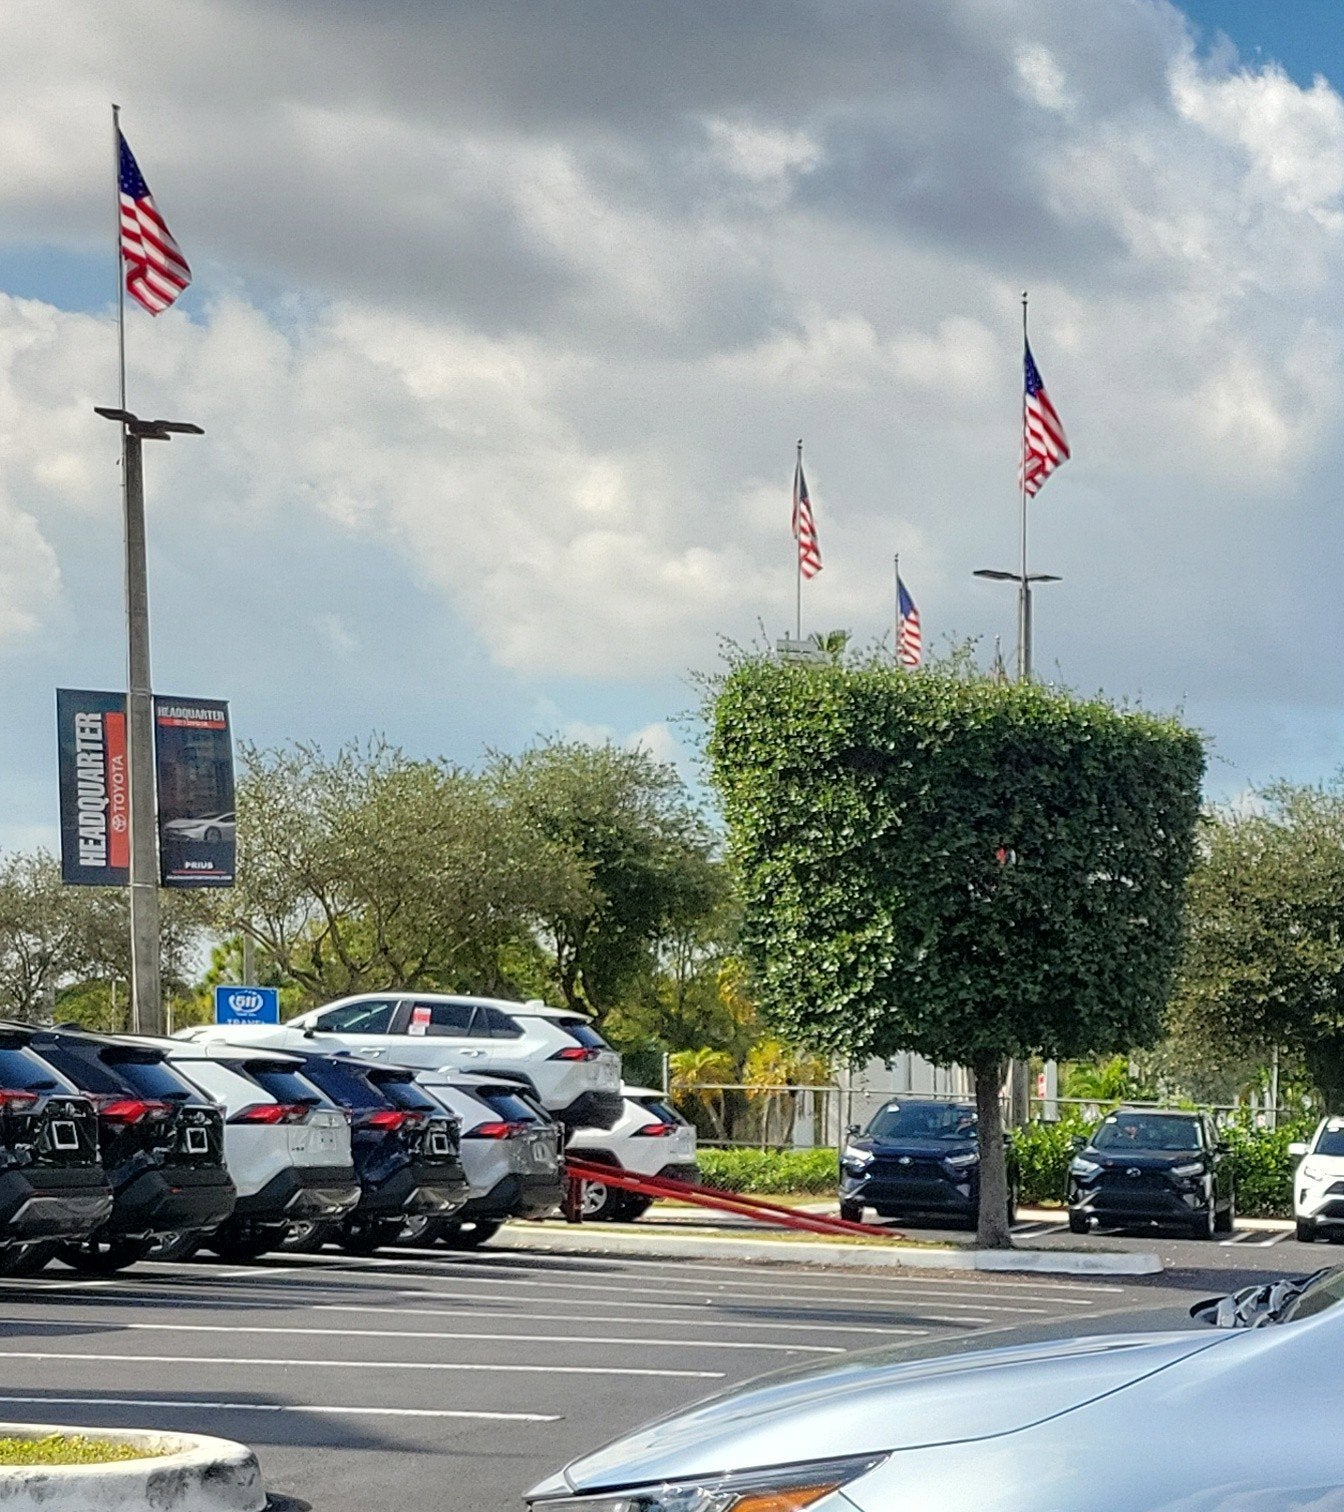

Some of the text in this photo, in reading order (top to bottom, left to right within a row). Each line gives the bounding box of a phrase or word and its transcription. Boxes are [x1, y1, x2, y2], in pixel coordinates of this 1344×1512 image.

[75, 712, 109, 867] HEADQUARTER
[112, 755, 125, 812] TOYOTA
[184, 861, 214, 869] PRIUS
[235, 995, 257, 1008] 511
